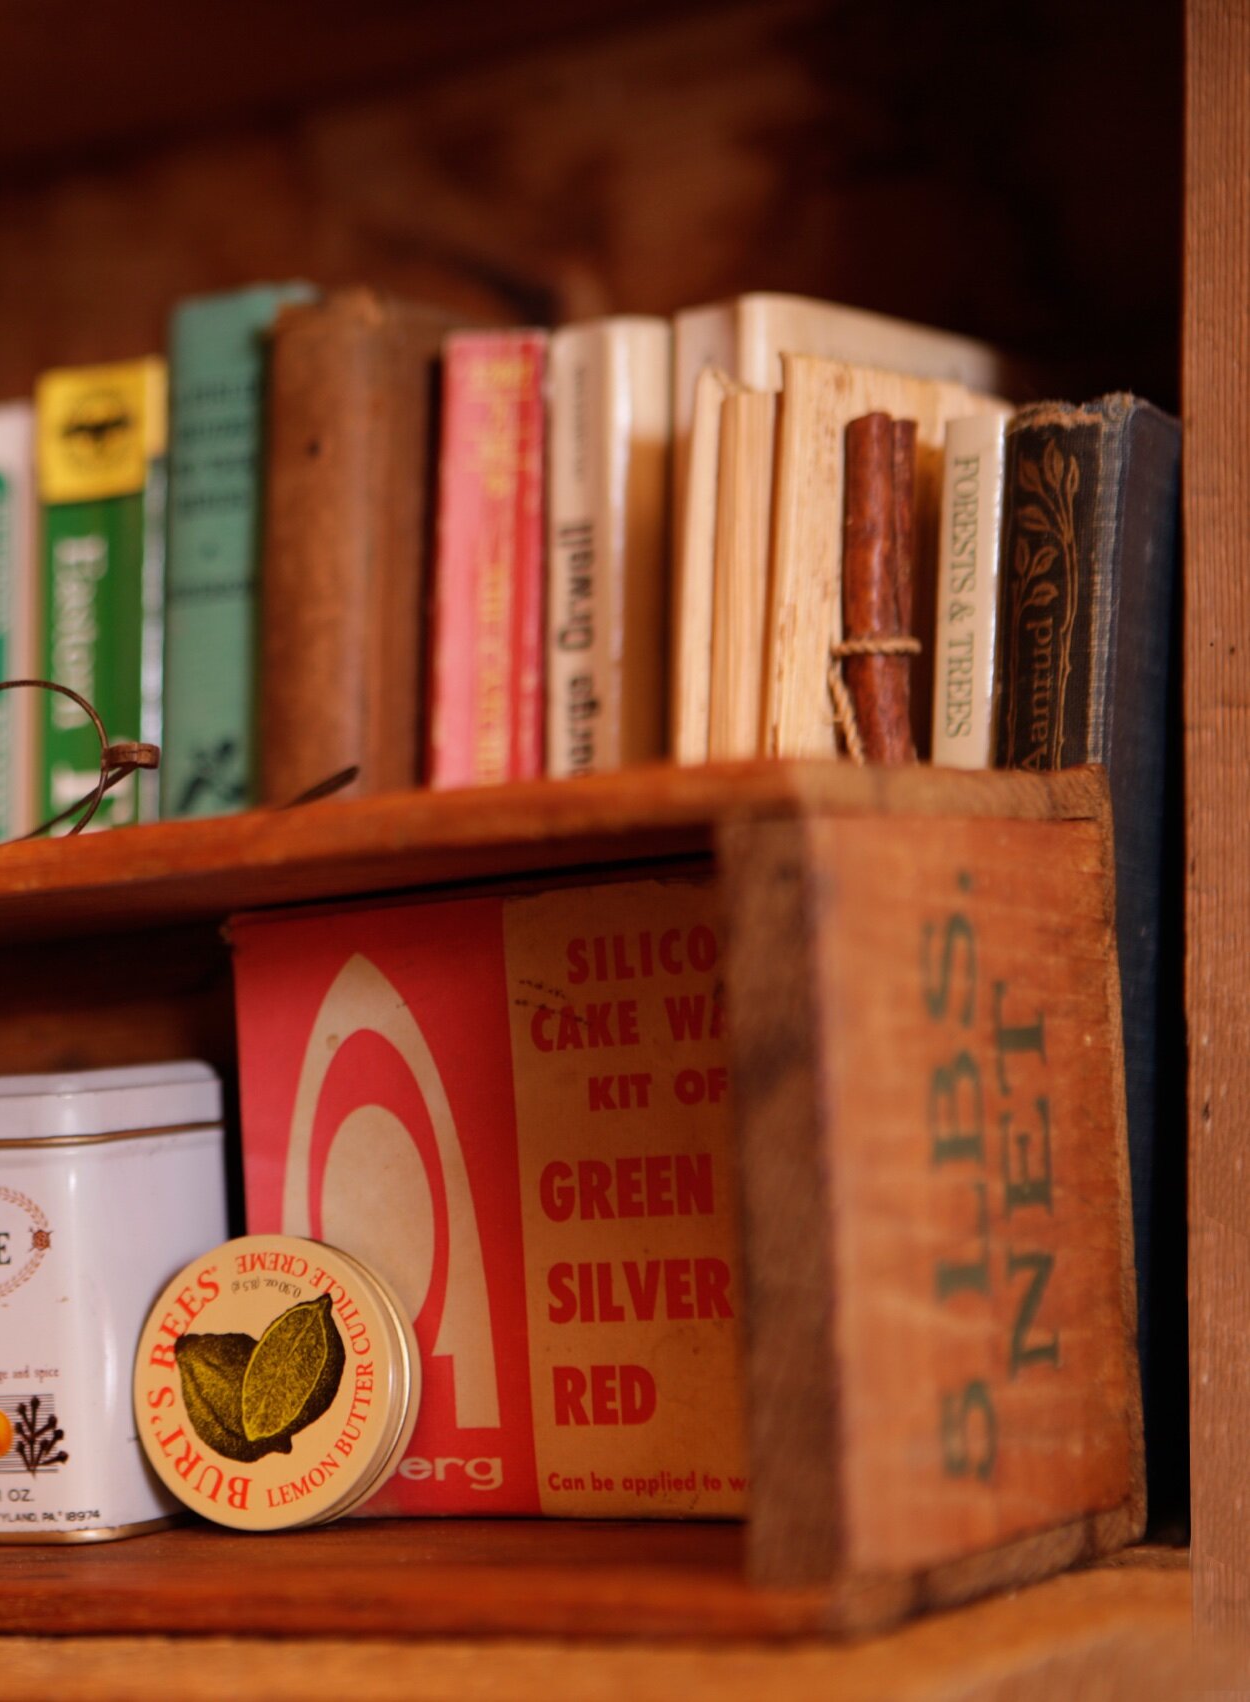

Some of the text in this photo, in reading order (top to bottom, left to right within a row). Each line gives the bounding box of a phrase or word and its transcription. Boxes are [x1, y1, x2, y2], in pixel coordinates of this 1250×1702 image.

[946, 455, 981, 739] FORESTS & TREES
[1021, 616, 1054, 771] Aanrud
[566, 925, 718, 985] SILICO
[530, 995, 727, 1053] CAKE WA
[587, 1066, 729, 1112] KIT OF
[539, 1153, 715, 1223] GREEN
[920, 868, 997, 1483] 5 LBS.
[993, 977, 1061, 1383] NET
[278, 1281, 302, 1299] 0.30
[546, 1257, 735, 1325] SILVER
[12, 1364, 30, 1380] and
[34, 1366, 60, 1384] spice
[147, 1267, 254, 1511] BURT'S BEES
[234, 1251, 374, 1508] LEMON BUTTER CUTICLE CREME
[552, 1363, 657, 1427] RED
[7, 1488, 36, 1502] OZ.
[392, 1455, 503, 1491] erg
[547, 1472, 586, 1492] Can
[591, 1471, 615, 1492] be
[622, 1471, 697, 1498] applied
[702, 1473, 722, 1492] to
[64, 1509, 101, 1522] 18974
